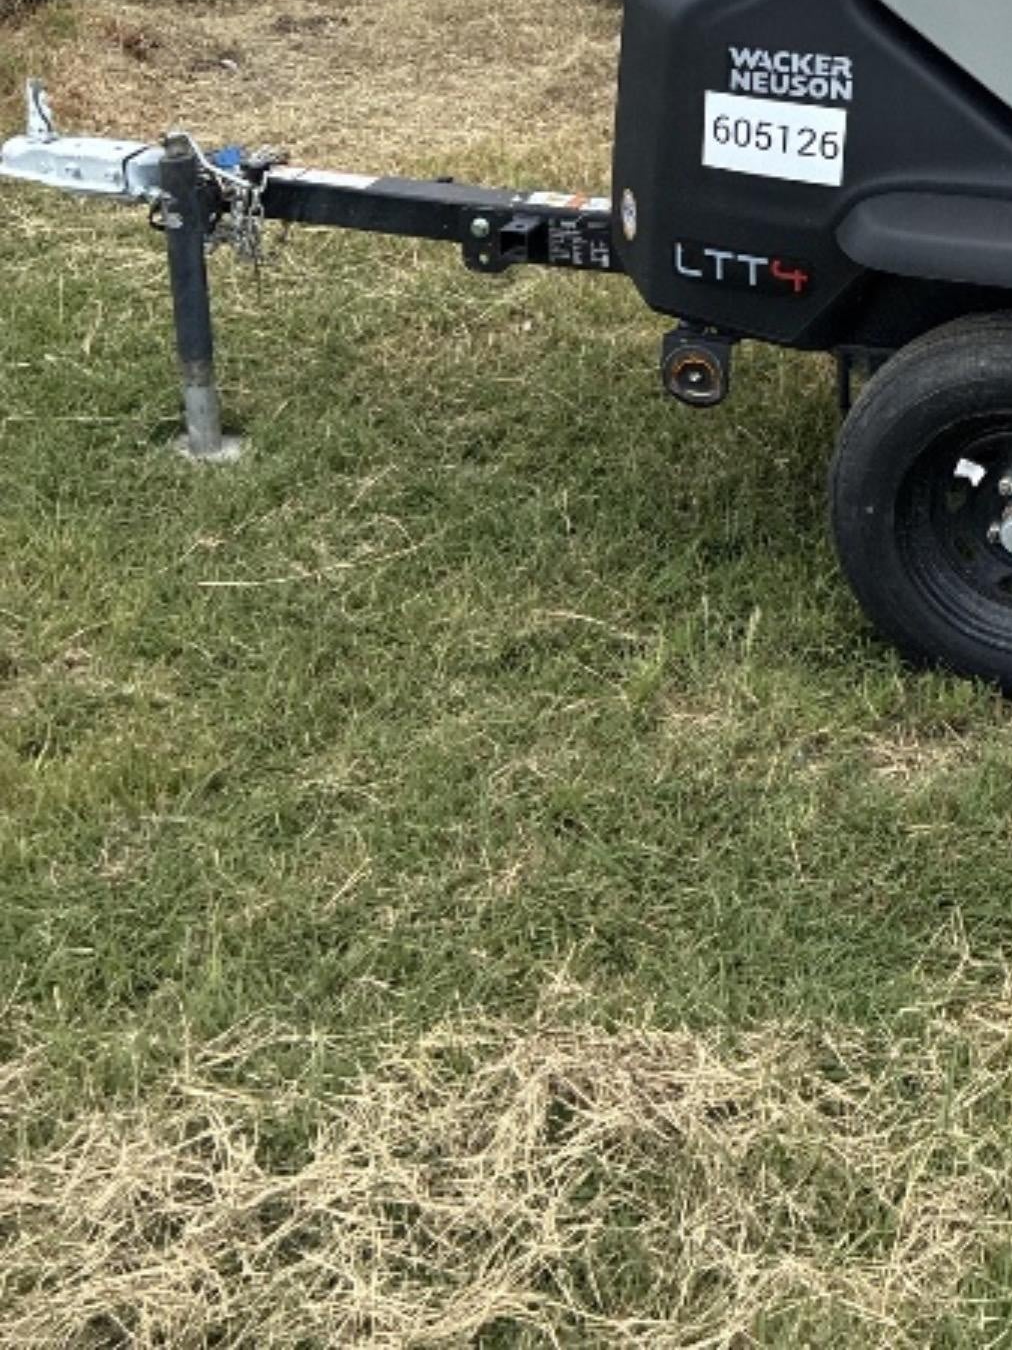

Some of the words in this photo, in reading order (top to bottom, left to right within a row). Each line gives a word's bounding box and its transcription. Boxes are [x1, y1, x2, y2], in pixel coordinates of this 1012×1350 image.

[728, 47, 853, 79] WACKER
[729, 69, 853, 100] NEUSON
[713, 114, 839, 160] 605126
[674, 241, 809, 293] LTT4
